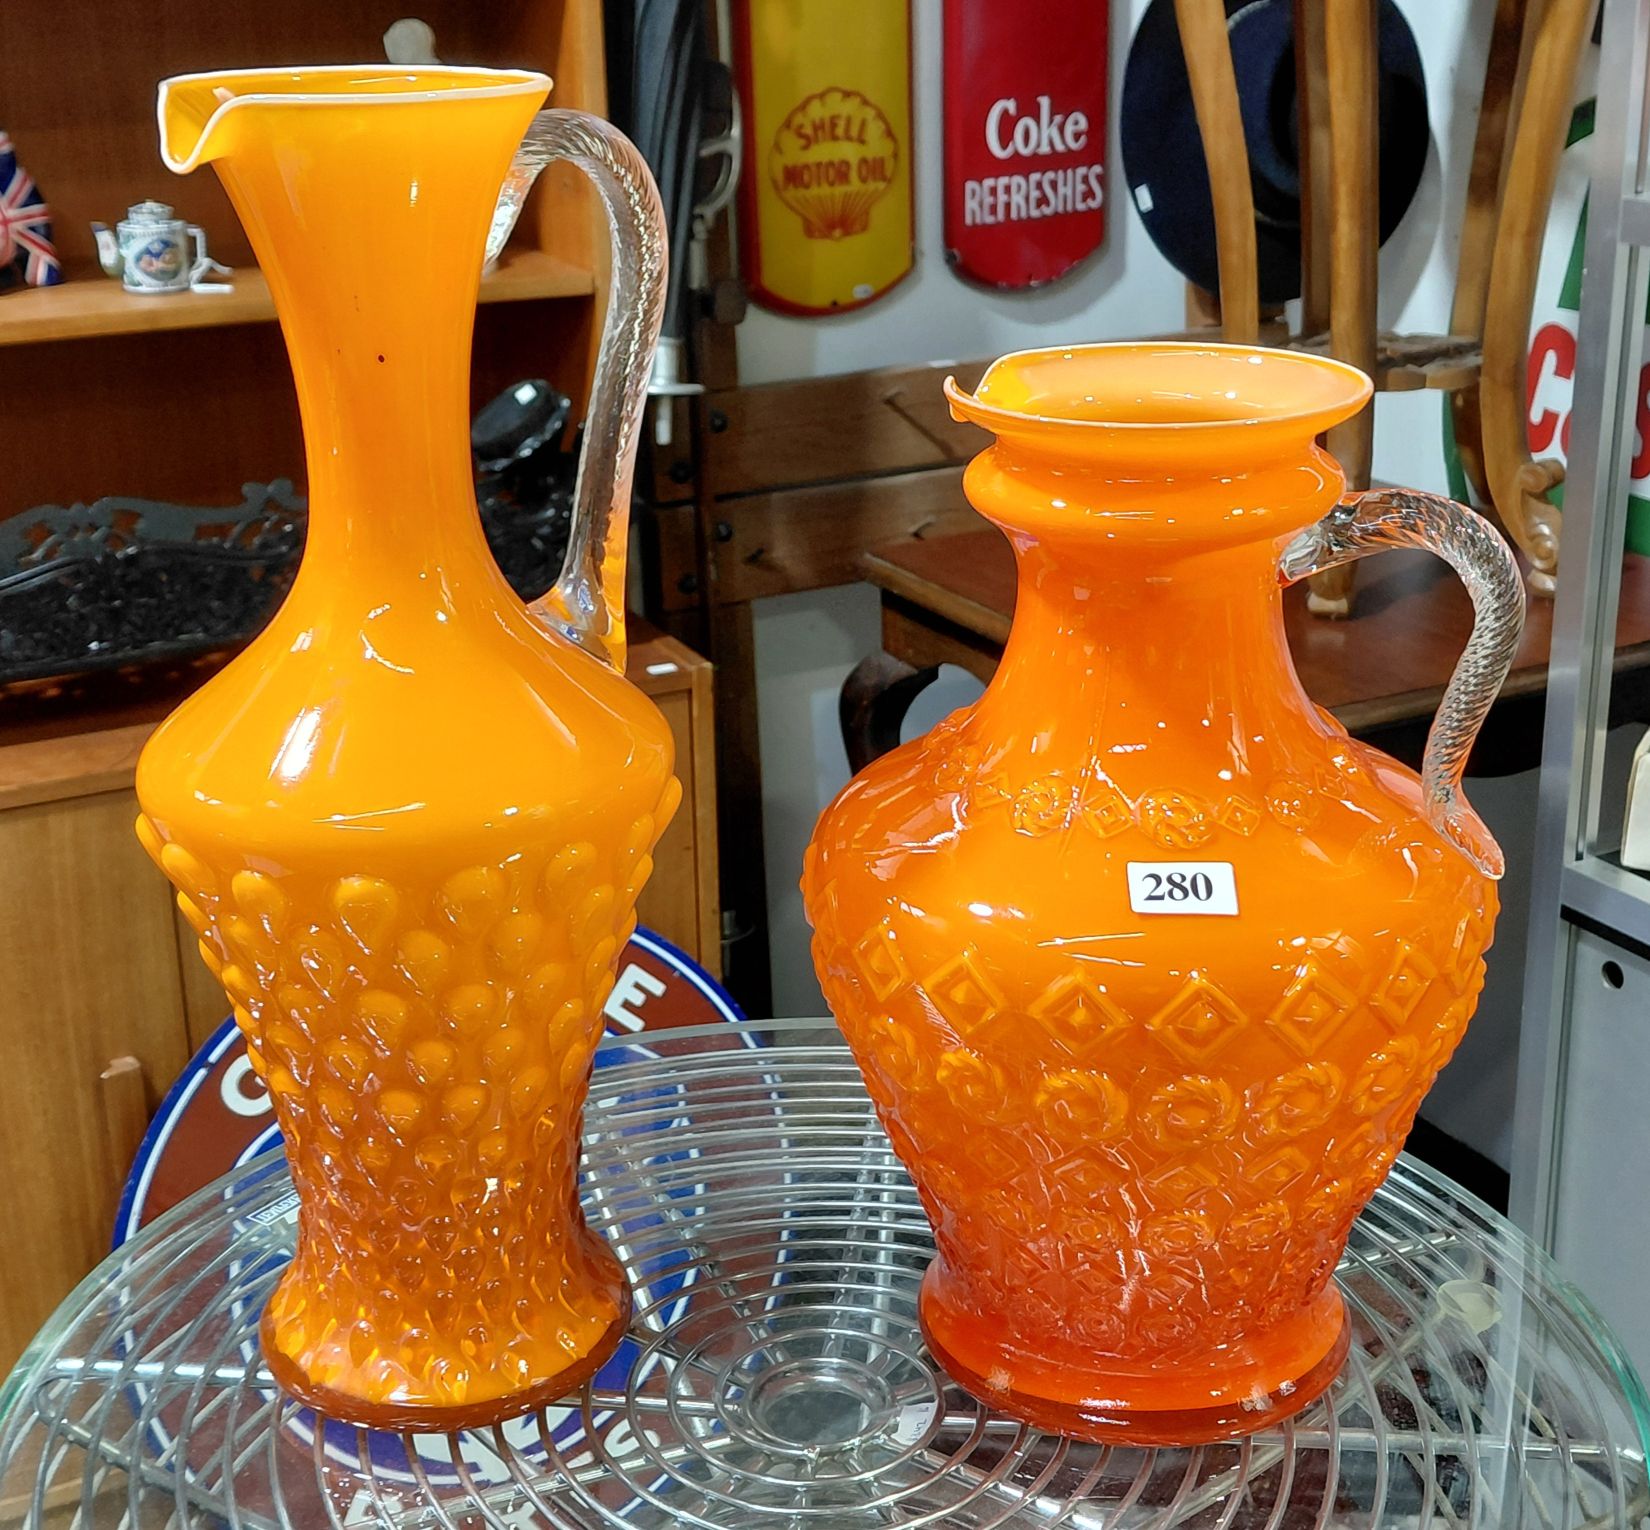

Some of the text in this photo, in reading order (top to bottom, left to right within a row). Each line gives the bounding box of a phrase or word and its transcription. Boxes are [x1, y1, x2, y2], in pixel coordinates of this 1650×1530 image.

[794, 115, 867, 151] SHELL
[985, 95, 1089, 160] Coke
[783, 157, 892, 191] MOTOR OIL
[964, 164, 1104, 226] REFRESHES
[1141, 872, 1213, 902] 280
